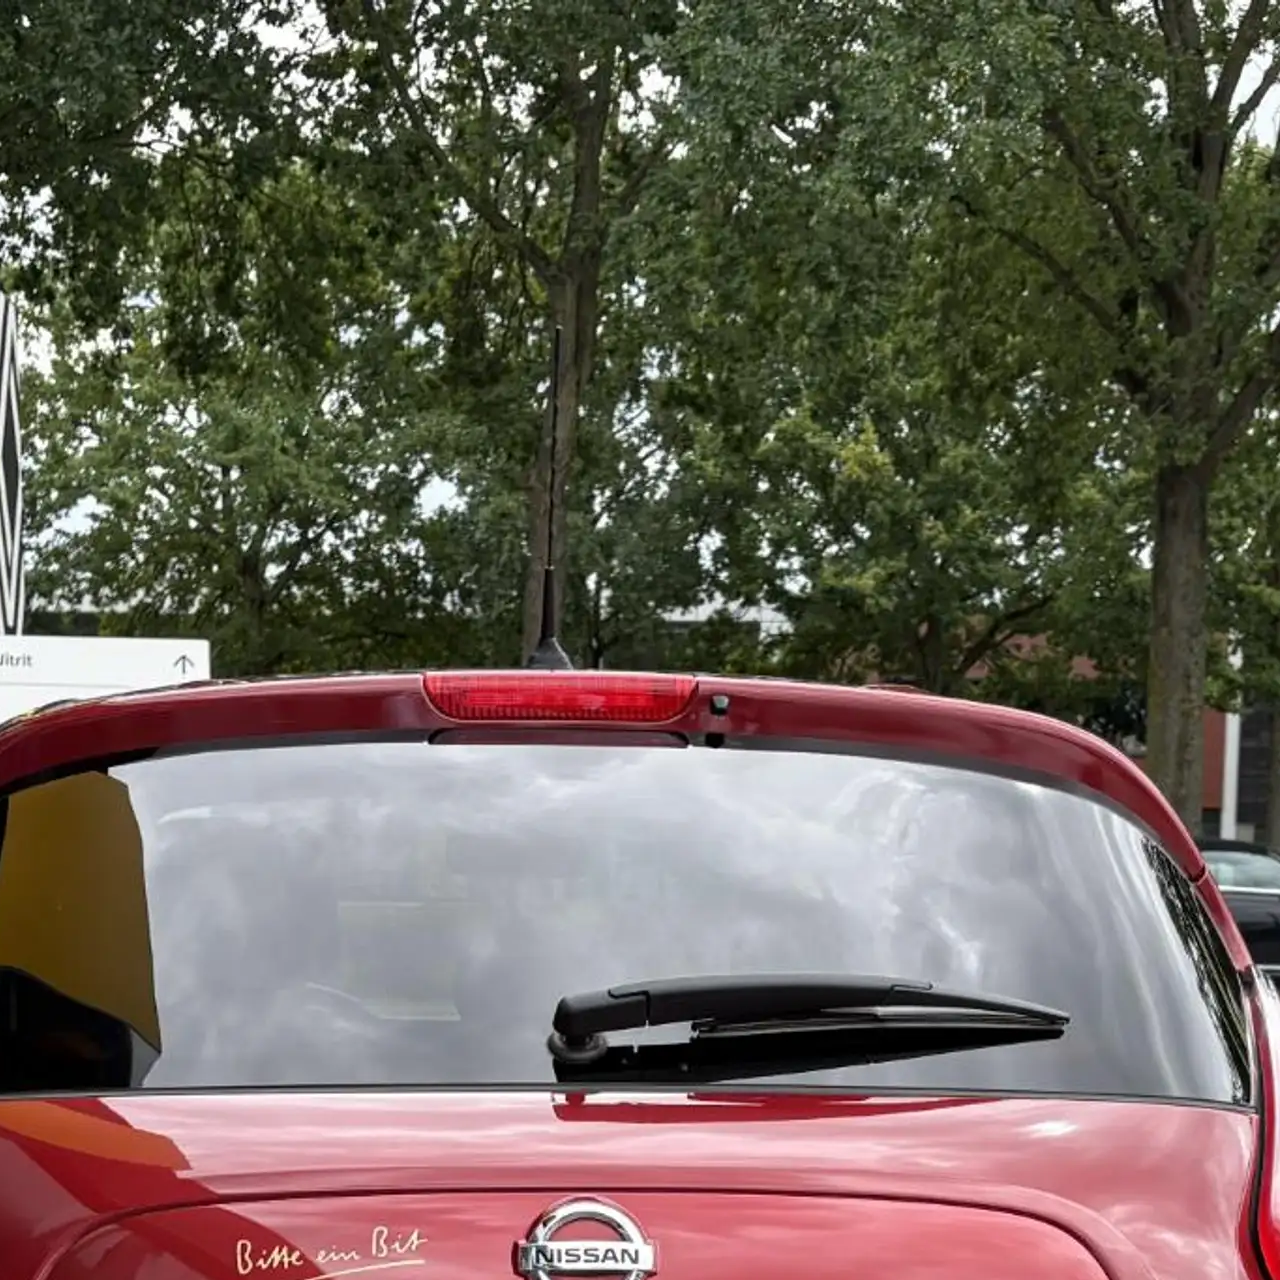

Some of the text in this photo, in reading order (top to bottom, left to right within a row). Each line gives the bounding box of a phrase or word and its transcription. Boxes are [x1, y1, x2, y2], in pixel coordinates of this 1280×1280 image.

[236, 1226, 428, 1275] Bitte ein Bit
[534, 1241, 640, 1265] NISSAN
